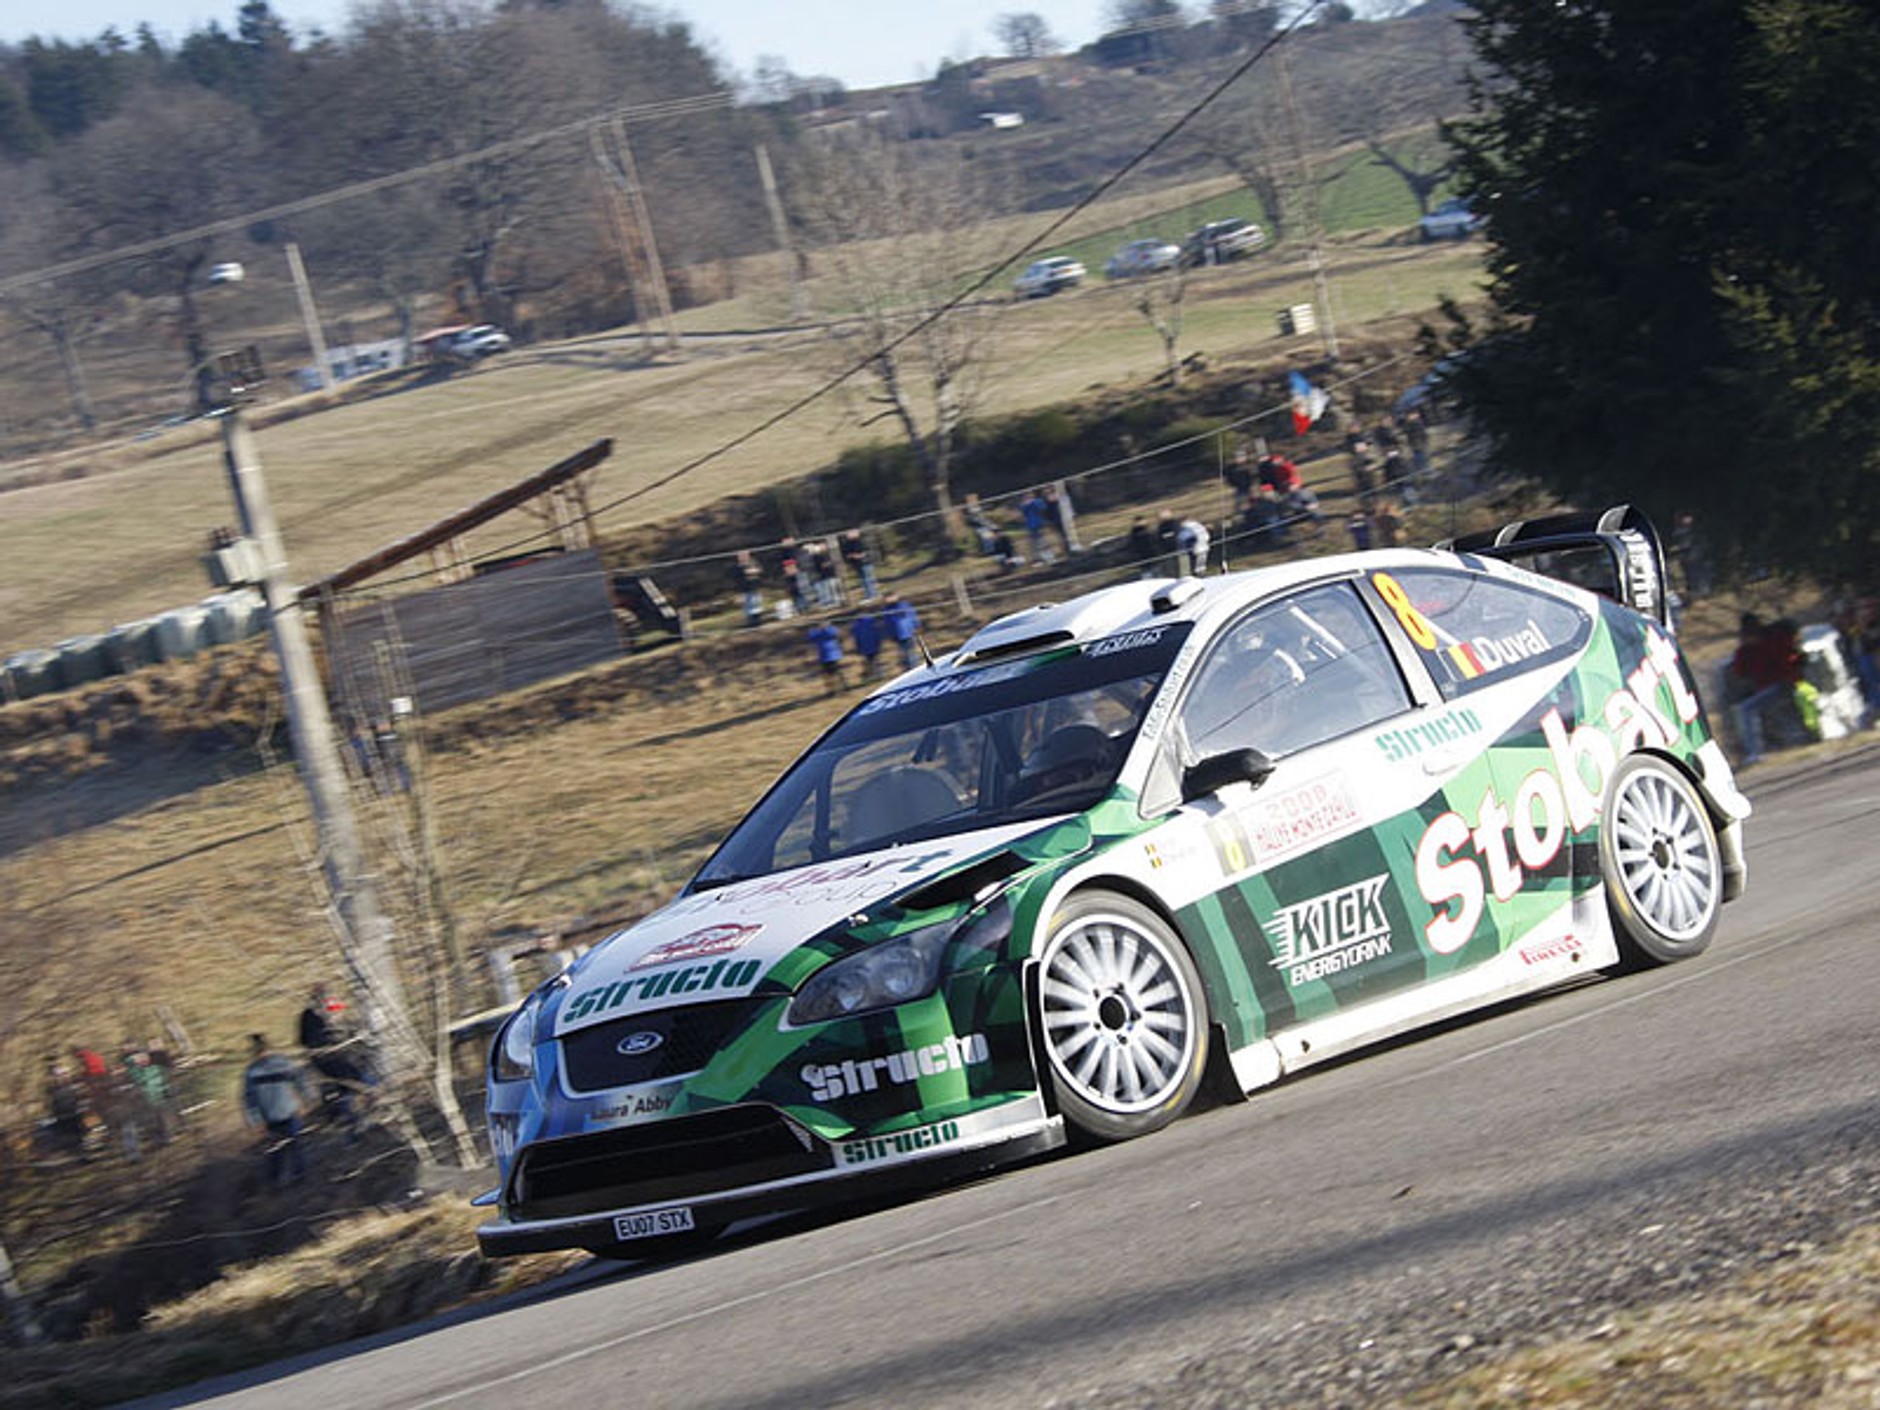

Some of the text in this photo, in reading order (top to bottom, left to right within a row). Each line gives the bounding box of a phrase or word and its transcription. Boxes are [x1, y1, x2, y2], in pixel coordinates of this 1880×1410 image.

[1372, 572, 1437, 651] 8
[1471, 619, 1552, 670] Duval
[1415, 621, 1699, 954] Stobart
[1284, 878, 1388, 962] KICK
[617, 1209, 691, 1238] EU07 STX
